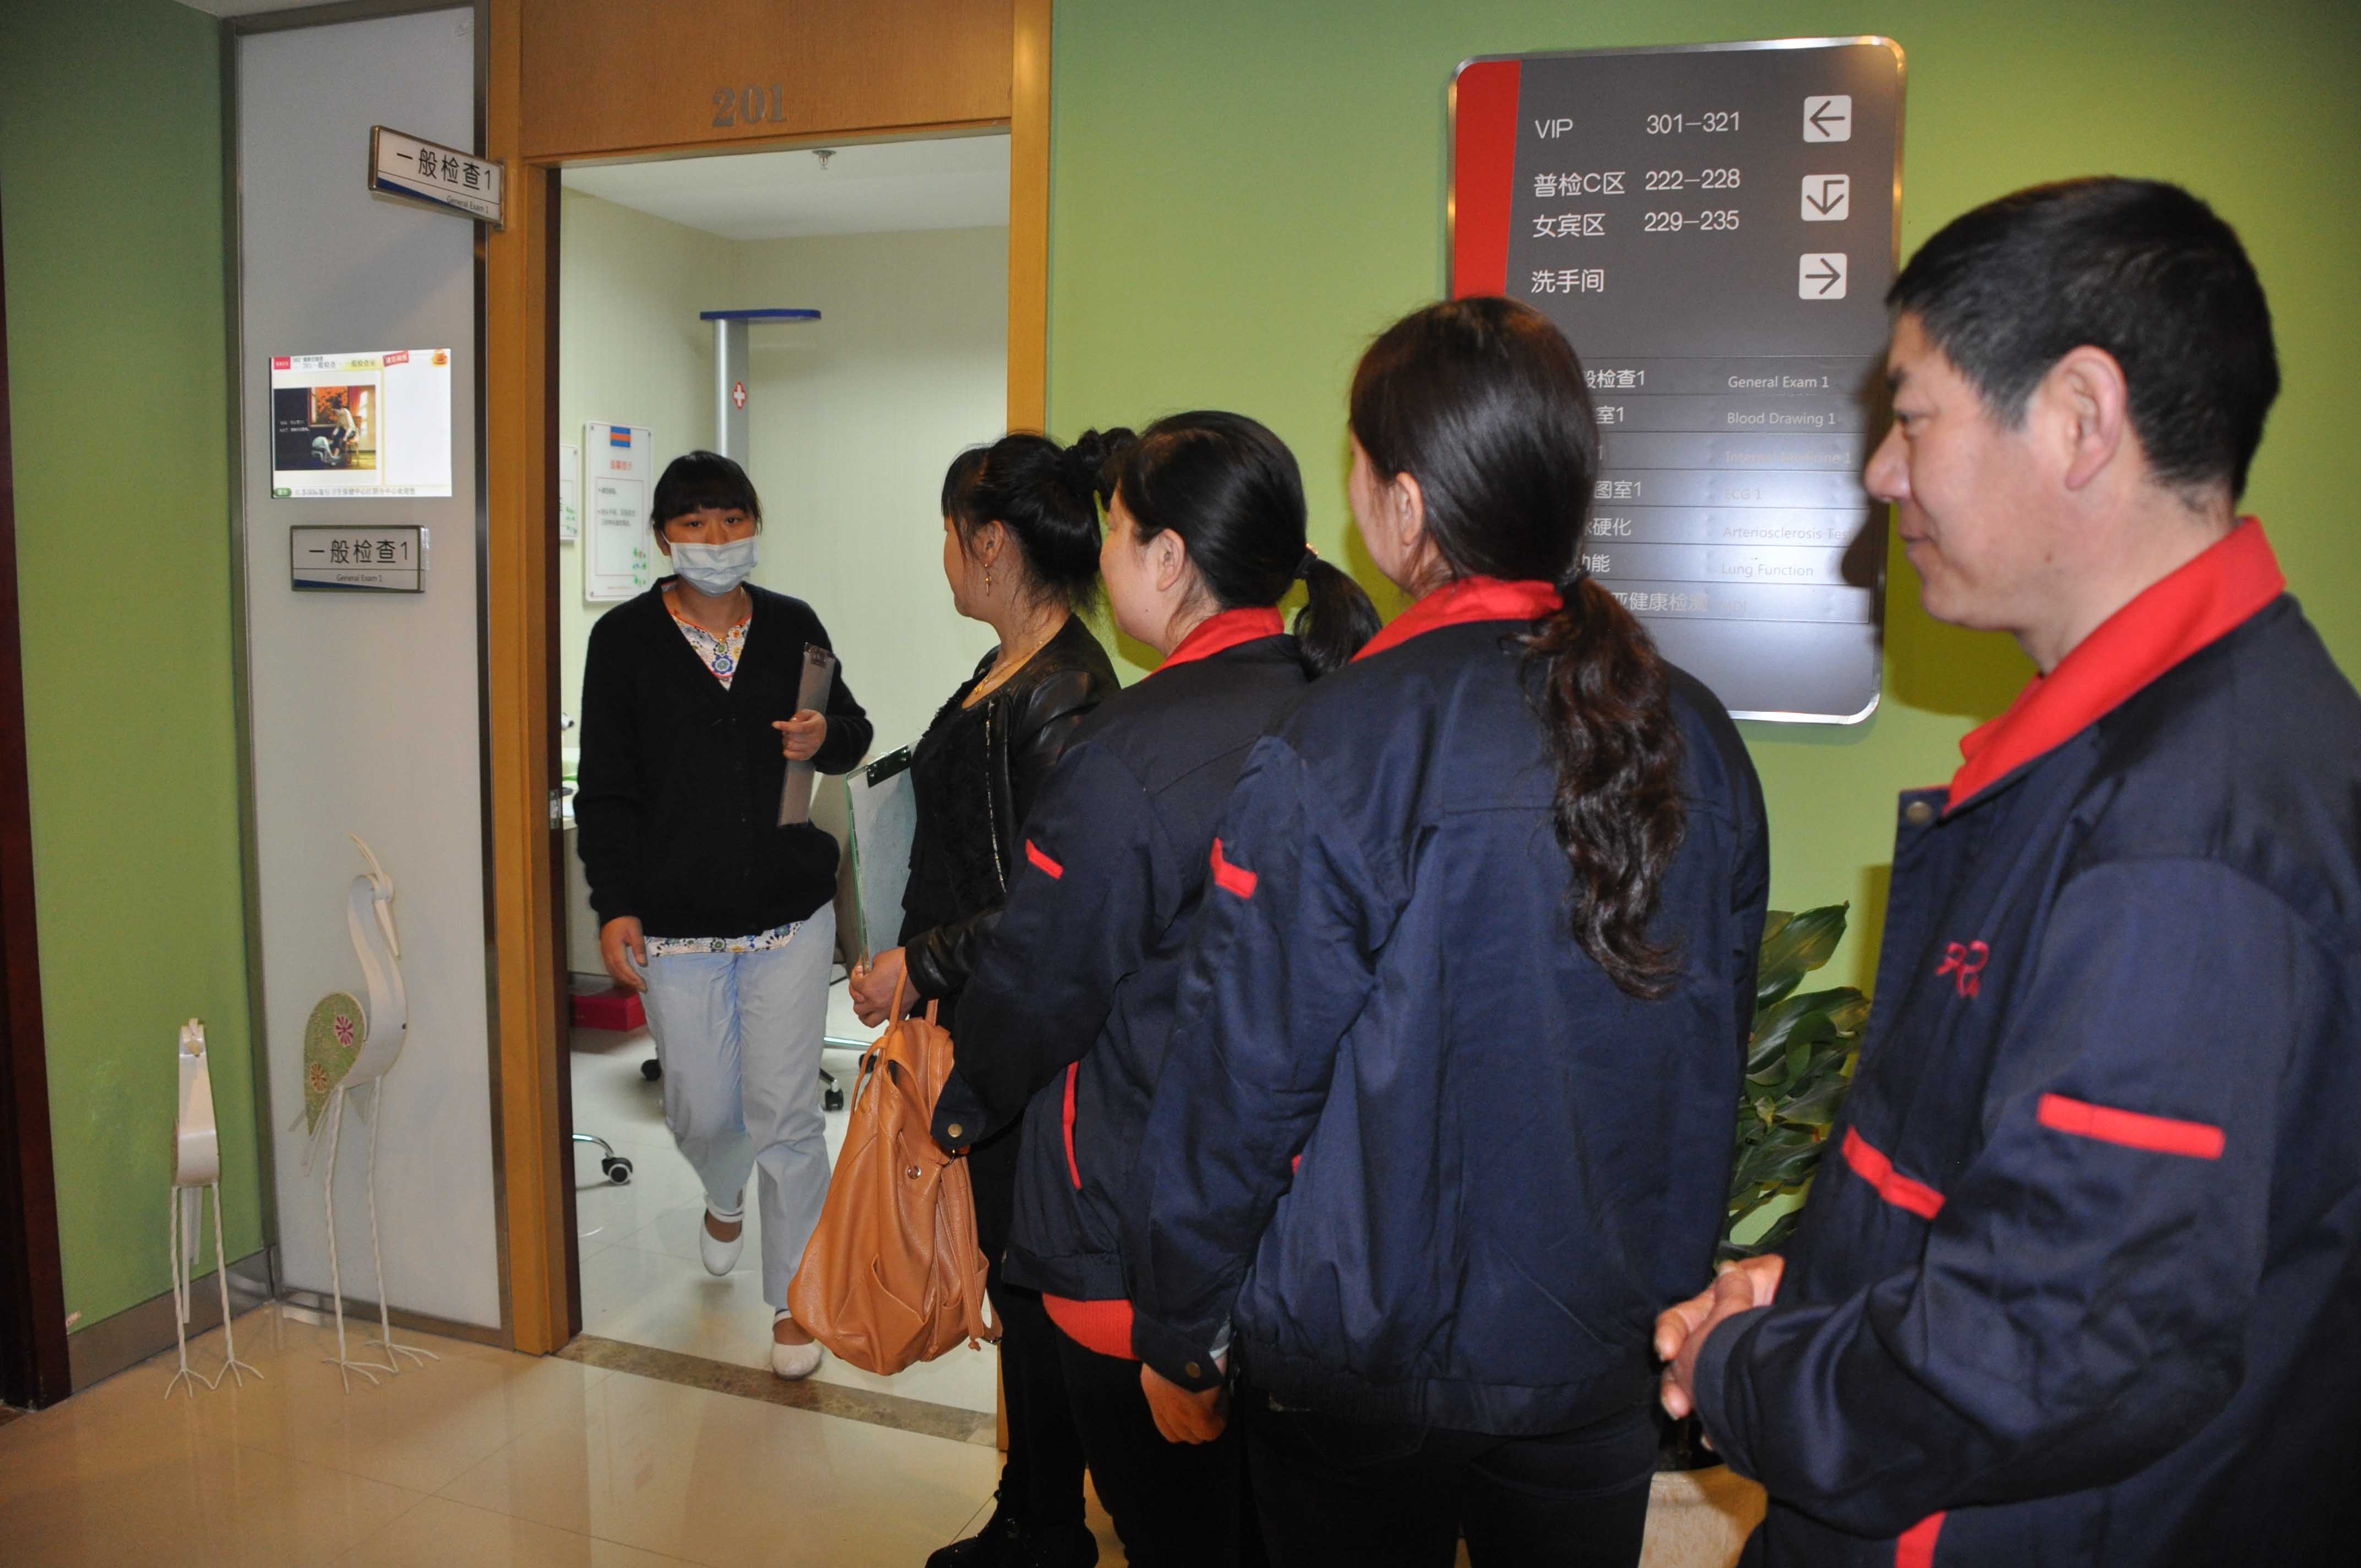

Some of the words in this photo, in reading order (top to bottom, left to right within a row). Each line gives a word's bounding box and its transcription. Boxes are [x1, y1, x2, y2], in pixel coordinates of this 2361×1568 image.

[713, 82, 790, 127] 201
[1534, 118, 1574, 139] VIP
[1646, 111, 1740, 134] 301-321
[396, 148, 492, 190] 一般检查1
[1645, 168, 1740, 190] 222-228
[1533, 171, 1626, 197] 普检C区
[447, 195, 469, 209] General
[469, 202, 485, 212] Exam
[1532, 213, 1606, 238] 女宾区
[1644, 210, 1740, 232] 229-235
[1531, 268, 1604, 293] 洗手间
[1728, 376, 1778, 388] General
[1783, 376, 1817, 388] Exam
[1821, 376, 1829, 388] 1
[1727, 412, 1765, 424] Blood
[1769, 413, 1824, 428] Drawing
[1829, 413, 1836, 424] 1
[1845, 452, 1851, 465] 1
[1725, 488, 1751, 500] ECG
[1755, 489, 1762, 500] 1
[1723, 526, 1822, 540] Arteriosclerosis
[309, 538, 409, 564] 一般检查1
[1722, 564, 1753, 578] Lung
[1758, 564, 1814, 576] Function
